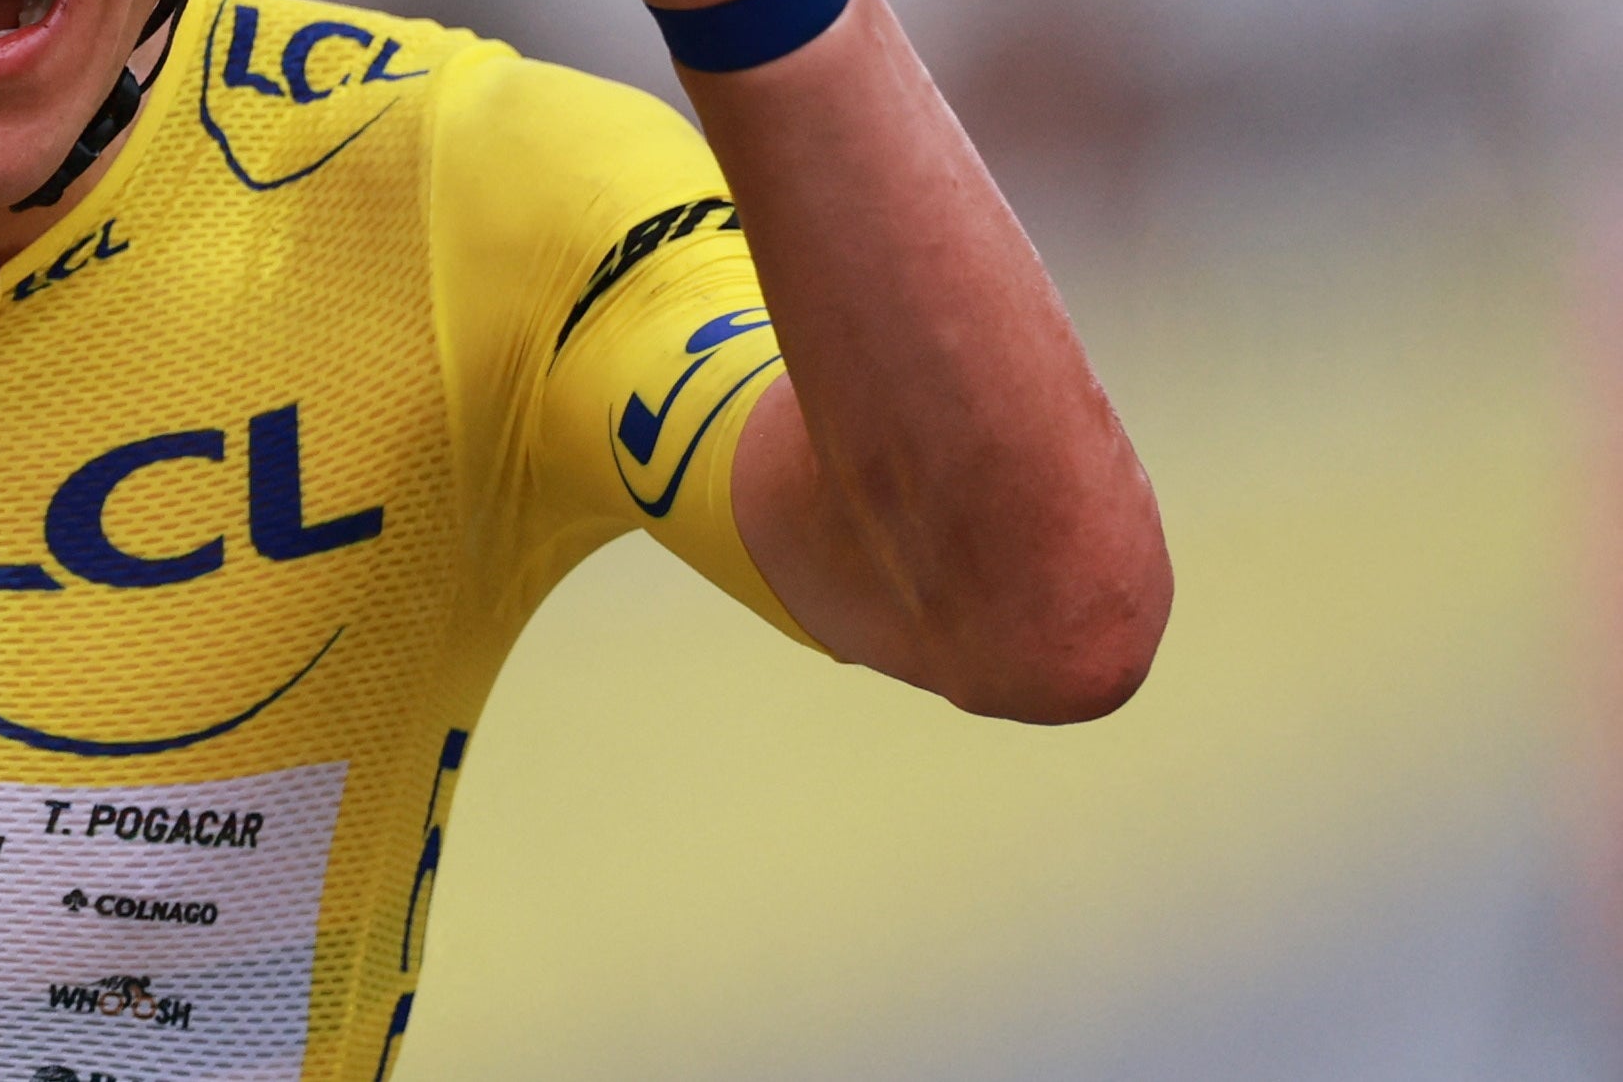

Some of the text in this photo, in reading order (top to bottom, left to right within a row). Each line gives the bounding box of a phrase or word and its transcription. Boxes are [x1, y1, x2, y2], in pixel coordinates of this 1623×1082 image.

[223, 5, 429, 104] LCL
[12, 219, 129, 301] LCL
[44, 800, 264, 848] T. POGACAR
[94, 894, 218, 925] COLNAGO
